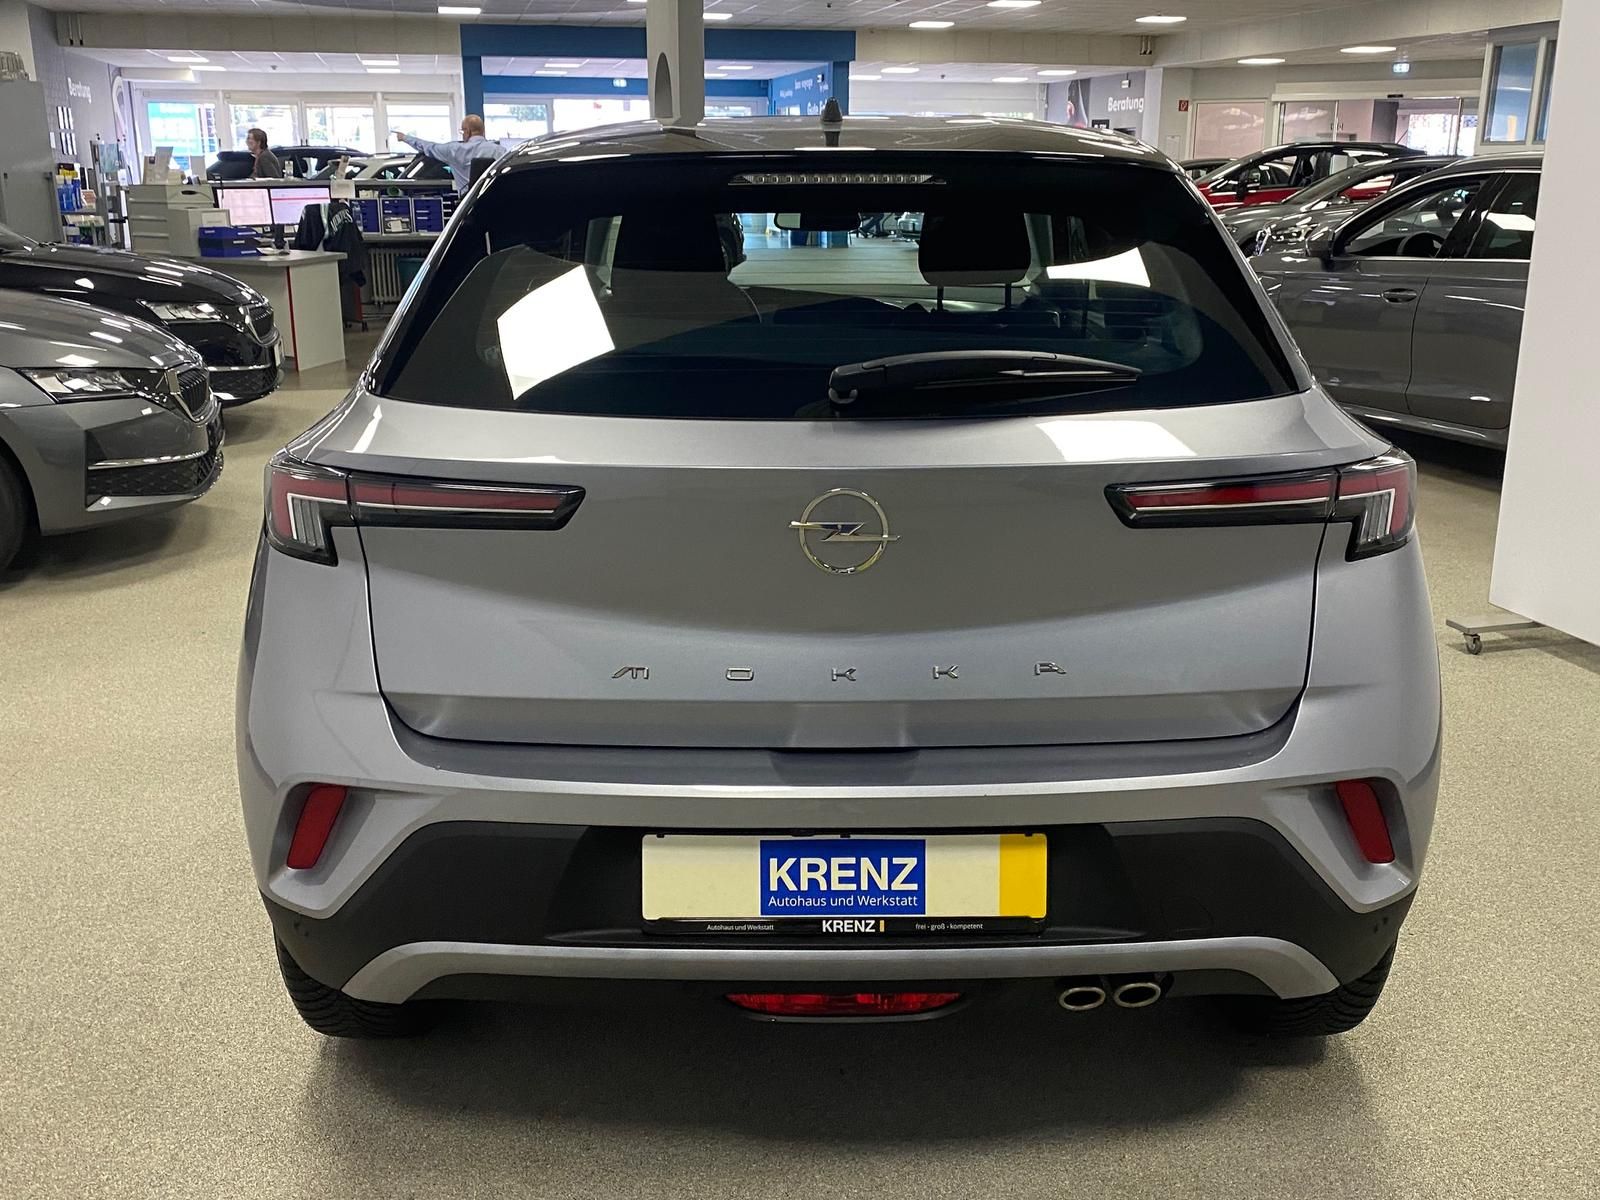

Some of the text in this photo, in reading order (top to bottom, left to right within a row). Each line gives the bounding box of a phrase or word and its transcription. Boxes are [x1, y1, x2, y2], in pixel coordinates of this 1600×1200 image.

[1107, 96, 1144, 113] Beratung
[769, 857, 918, 891] KRENZ
[768, 895, 918, 907] Autohaus und Werkstatt
[822, 920, 876, 933] KRENZ
[915, 922, 984, 931] frei groß kompetent
